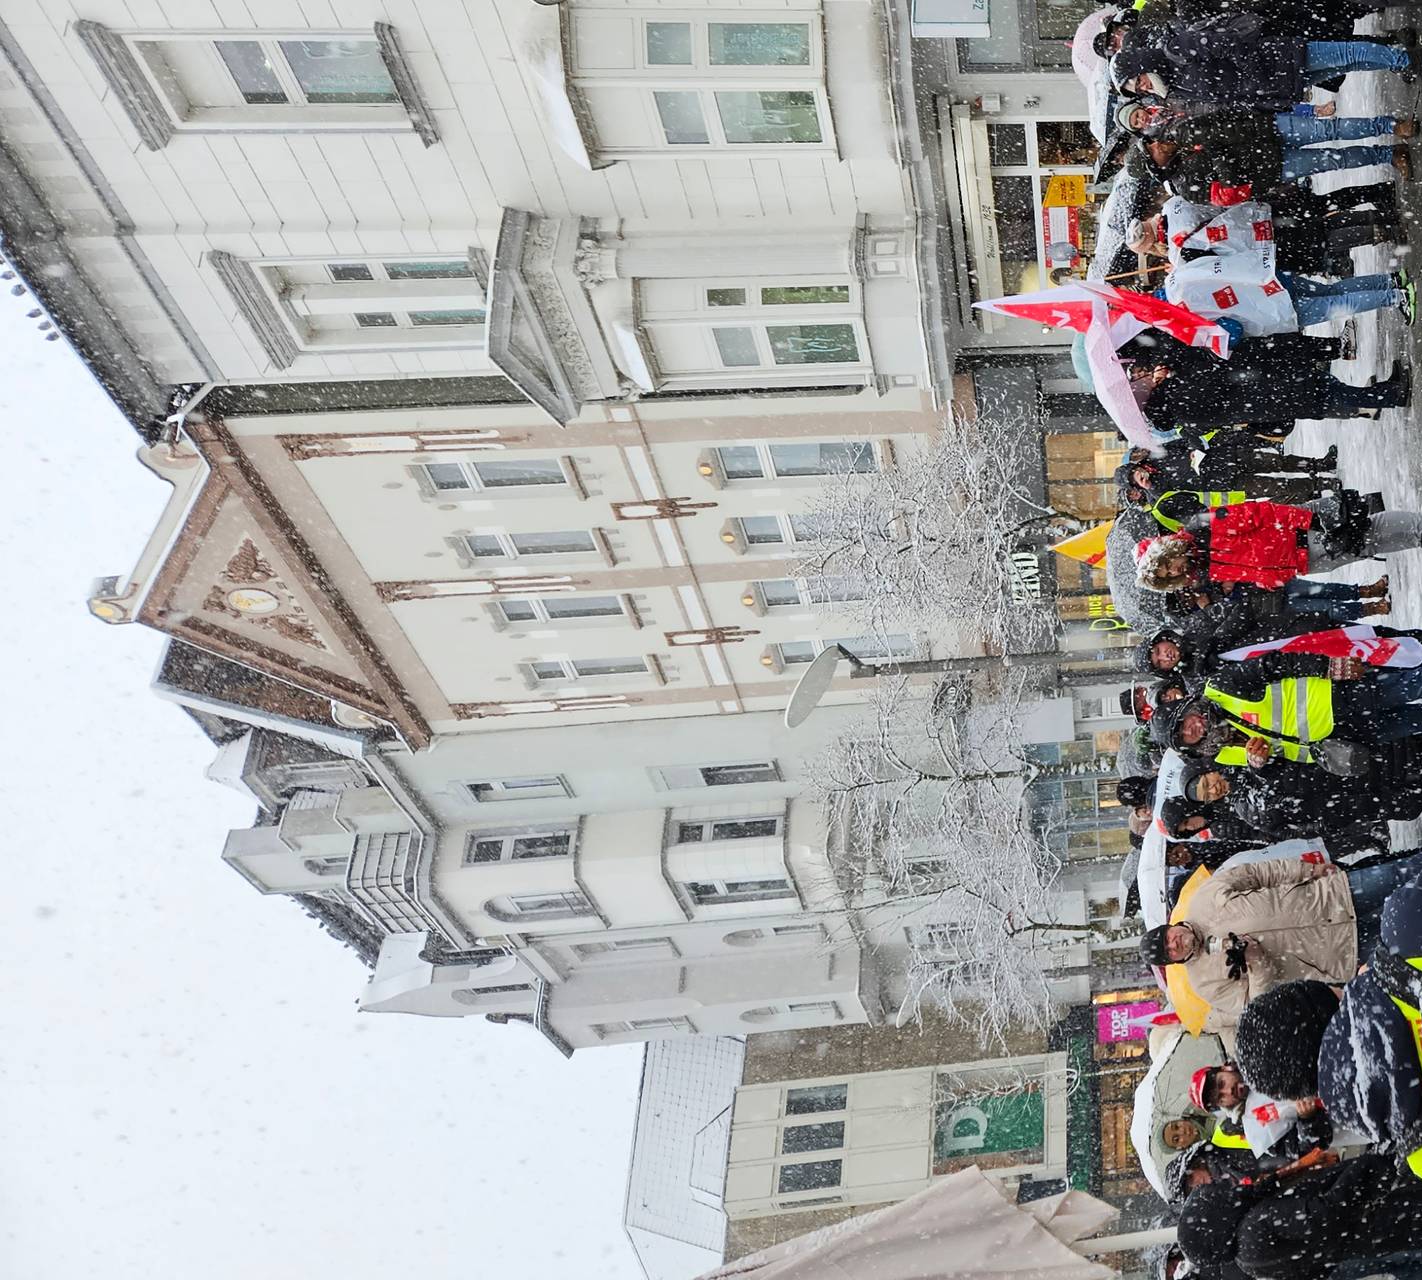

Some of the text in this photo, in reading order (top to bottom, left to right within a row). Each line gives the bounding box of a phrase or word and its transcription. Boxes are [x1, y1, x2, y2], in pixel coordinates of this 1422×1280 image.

[1088, 595, 1102, 616] NICE
[1104, 604, 1116, 618] TO
[1164, 768, 1176, 799] TREIK
[1111, 1009, 1120, 1038] TOP
[1120, 1008, 1129, 1037] DEAL
